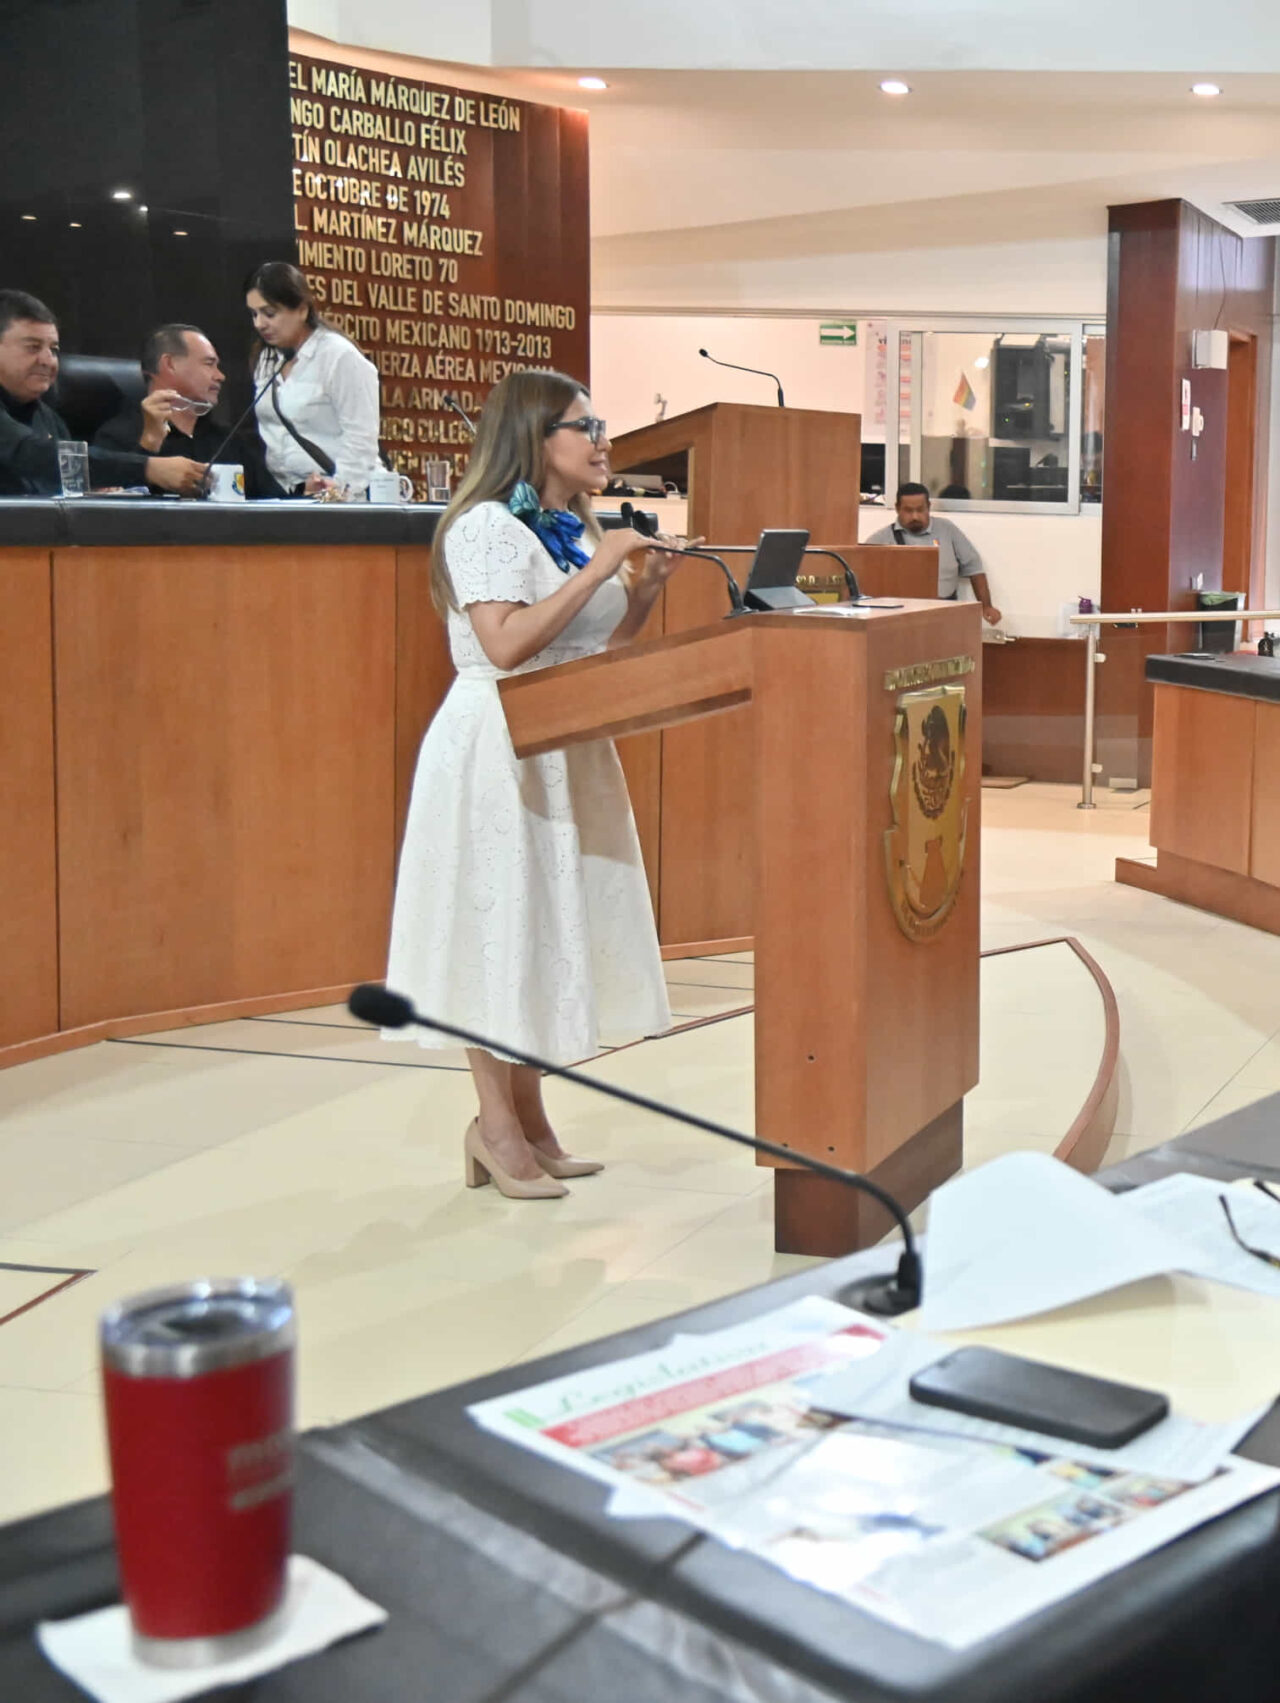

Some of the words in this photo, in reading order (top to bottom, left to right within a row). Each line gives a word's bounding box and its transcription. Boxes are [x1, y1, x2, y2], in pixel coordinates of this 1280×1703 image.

[311, 68, 367, 104] MARÍA
[370, 77, 450, 120] MÁRQUEZ
[454, 96, 476, 126] DE
[479, 99, 521, 132] LEÓN
[290, 96, 325, 130] NGO
[329, 105, 416, 147] CARBALLO
[420, 121, 468, 155] FÉLIX
[292, 129, 320, 164] TÍN
[324, 138, 403, 178] OLACHEA
[407, 155, 466, 188] AVILÉS
[304, 171, 381, 208] OCTUBRE
[386, 183, 409, 212] DE
[413, 189, 451, 219] 1974
[313, 207, 398, 244] MARTÍNEZ
[402, 218, 483, 256] MÁRQUEZ
[370, 249, 432, 281] LORETO
[438, 258, 458, 283] 70
[331, 278, 363, 307] DEL
[367, 282, 417, 313] VALLE
[422, 289, 444, 316] DE
[448, 292, 499, 321] SANTO
[504, 298, 575, 331] DOMINGO
[386, 317, 470, 350] MEXICANO
[476, 328, 551, 359] 1913-2013
[424, 350, 475, 382] AÉREA
[381, 384, 404, 408] LA
